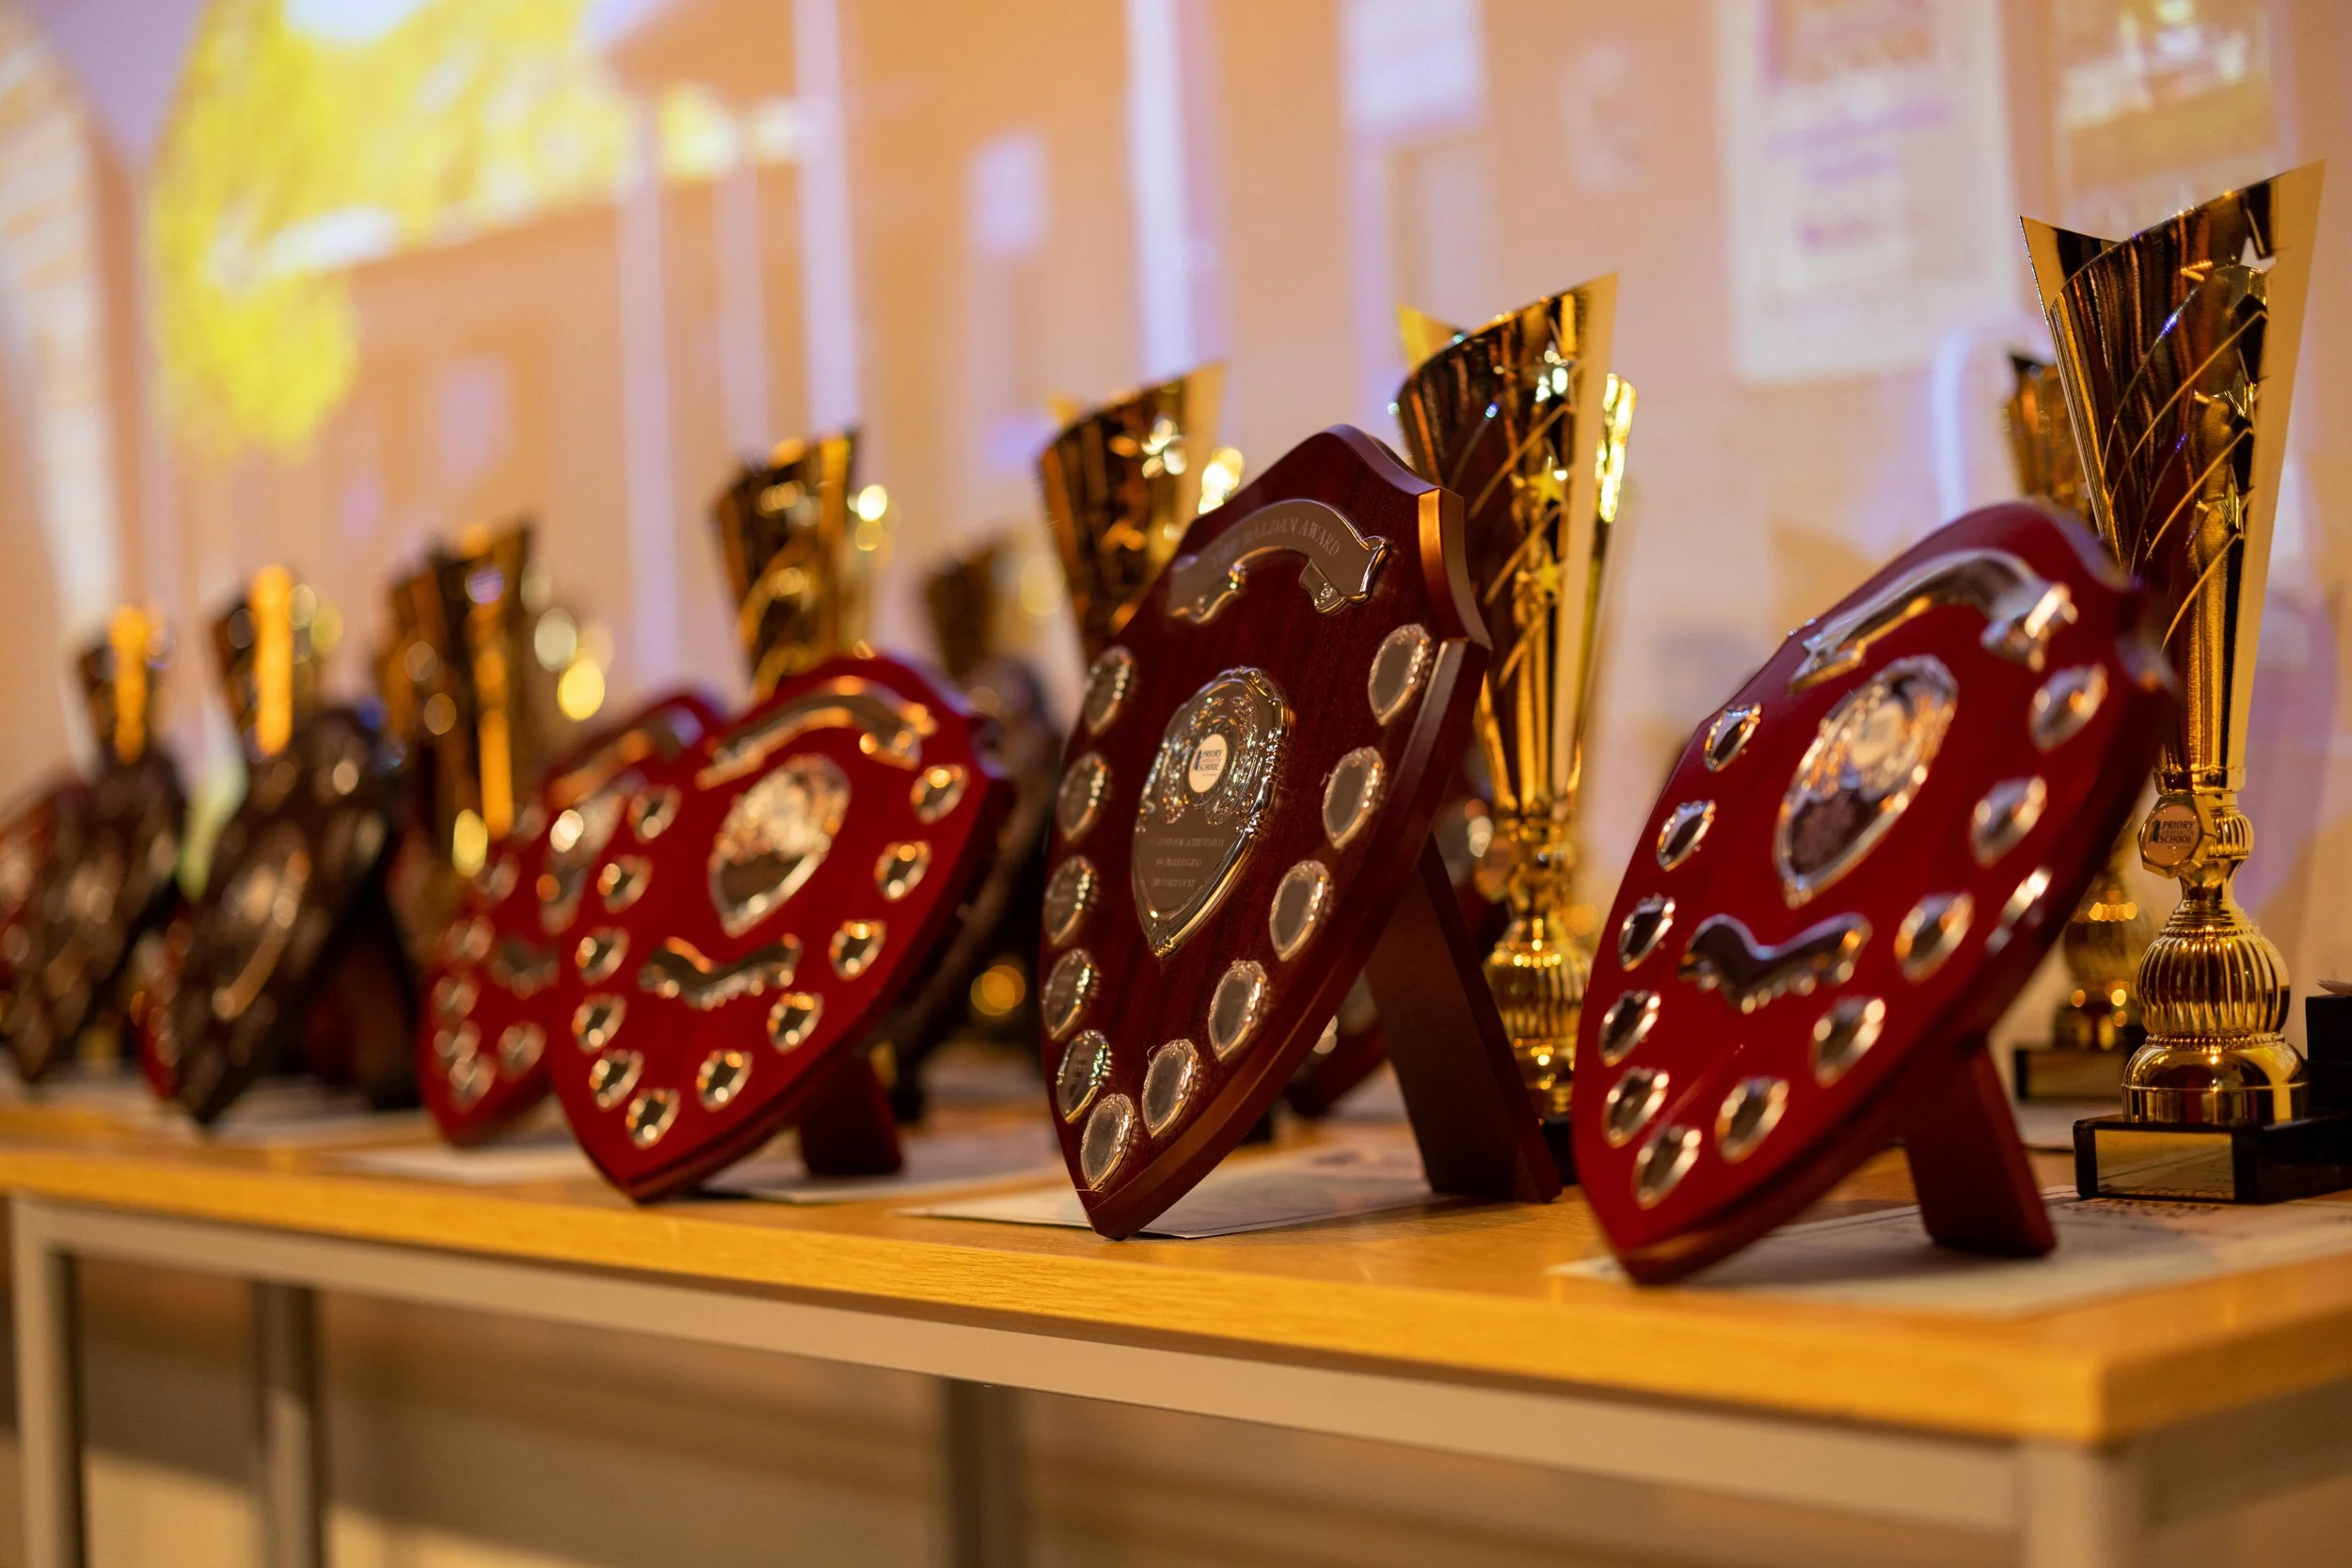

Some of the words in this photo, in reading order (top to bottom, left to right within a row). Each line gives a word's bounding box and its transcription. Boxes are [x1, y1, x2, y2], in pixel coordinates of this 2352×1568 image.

[1297, 517, 1341, 557] AWARD
[1202, 749, 1223, 757] PRIORY
[1200, 763, 1219, 771] SCHOOL
[2163, 820, 2194, 829] PRIORY
